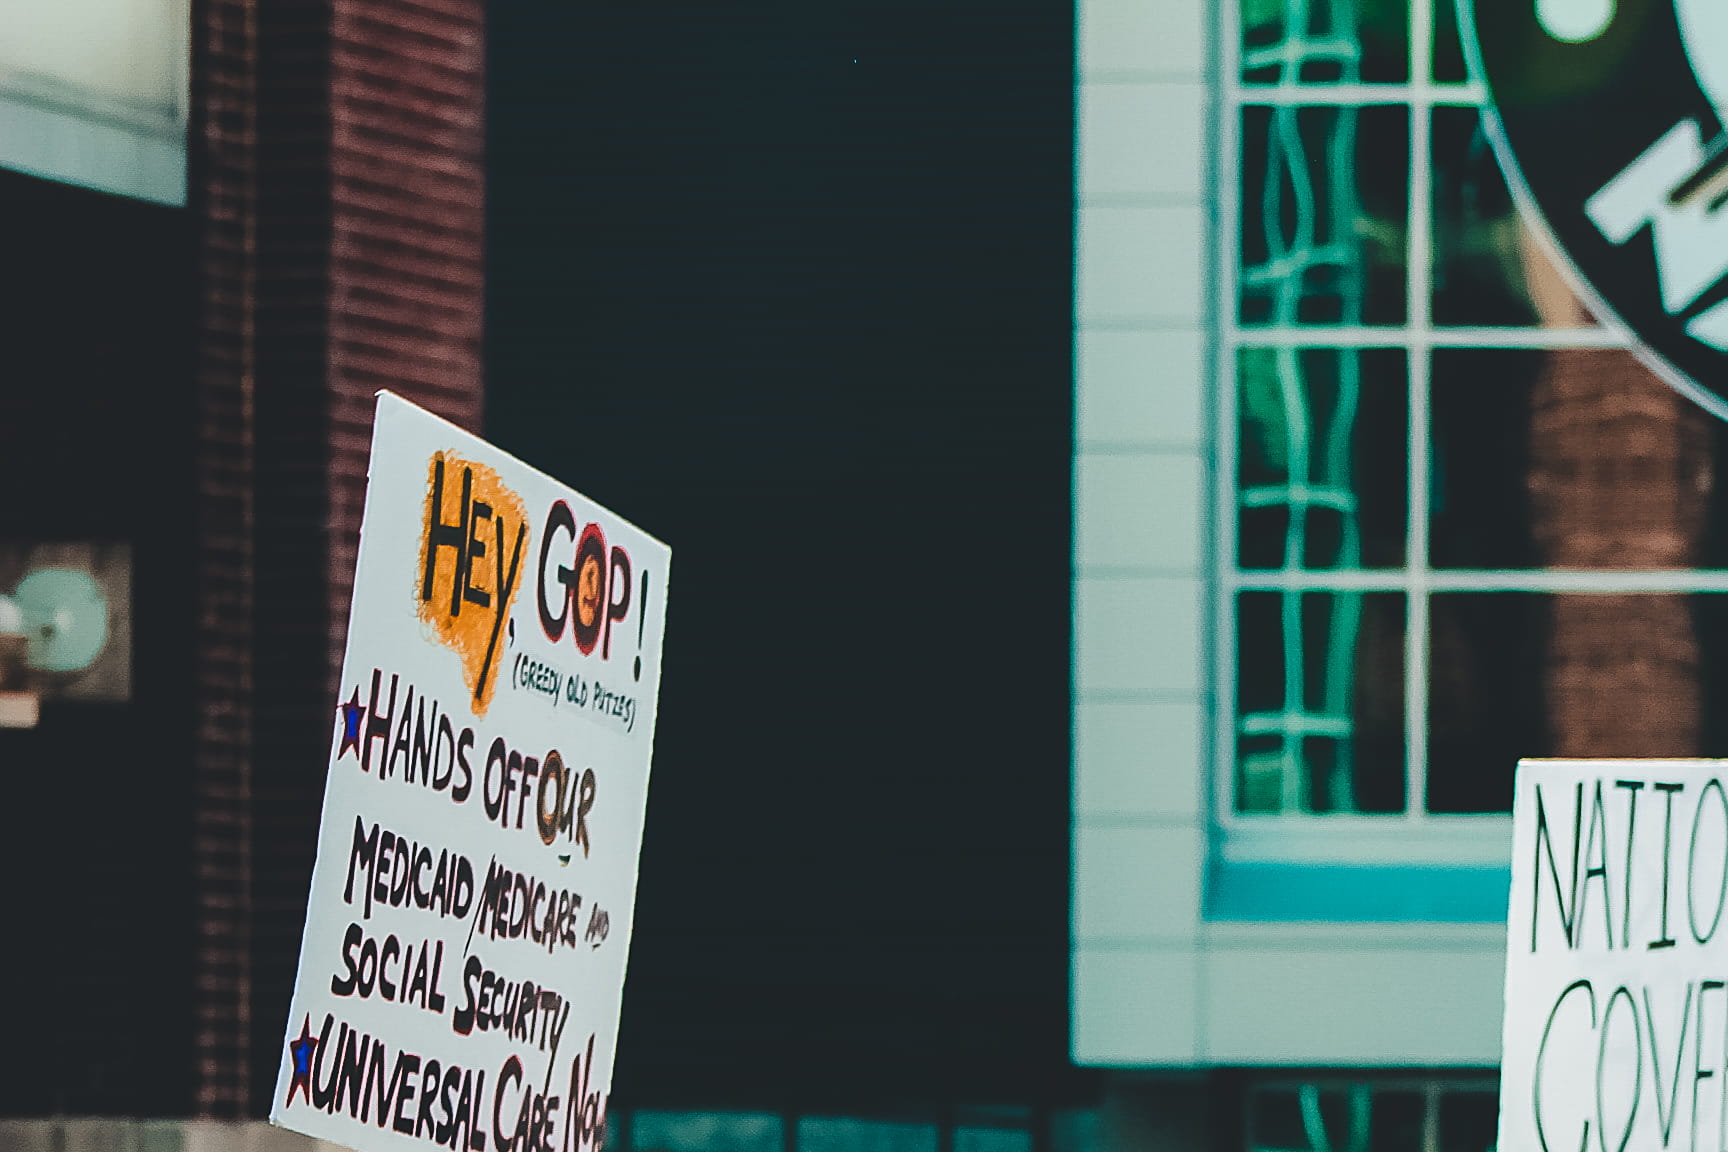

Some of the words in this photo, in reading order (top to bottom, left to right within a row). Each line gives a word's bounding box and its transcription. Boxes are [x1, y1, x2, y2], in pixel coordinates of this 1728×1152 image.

[538, 498, 648, 683] GOP!
[361, 667, 475, 804] HANDS
[484, 737, 539, 829] OFF
[537, 749, 596, 858] OUR
[566, 674, 588, 707] OLD
[343, 814, 474, 920] MEDICAID
[331, 922, 445, 1014] SOCIAL
[453, 955, 570, 1095] SECURITY
